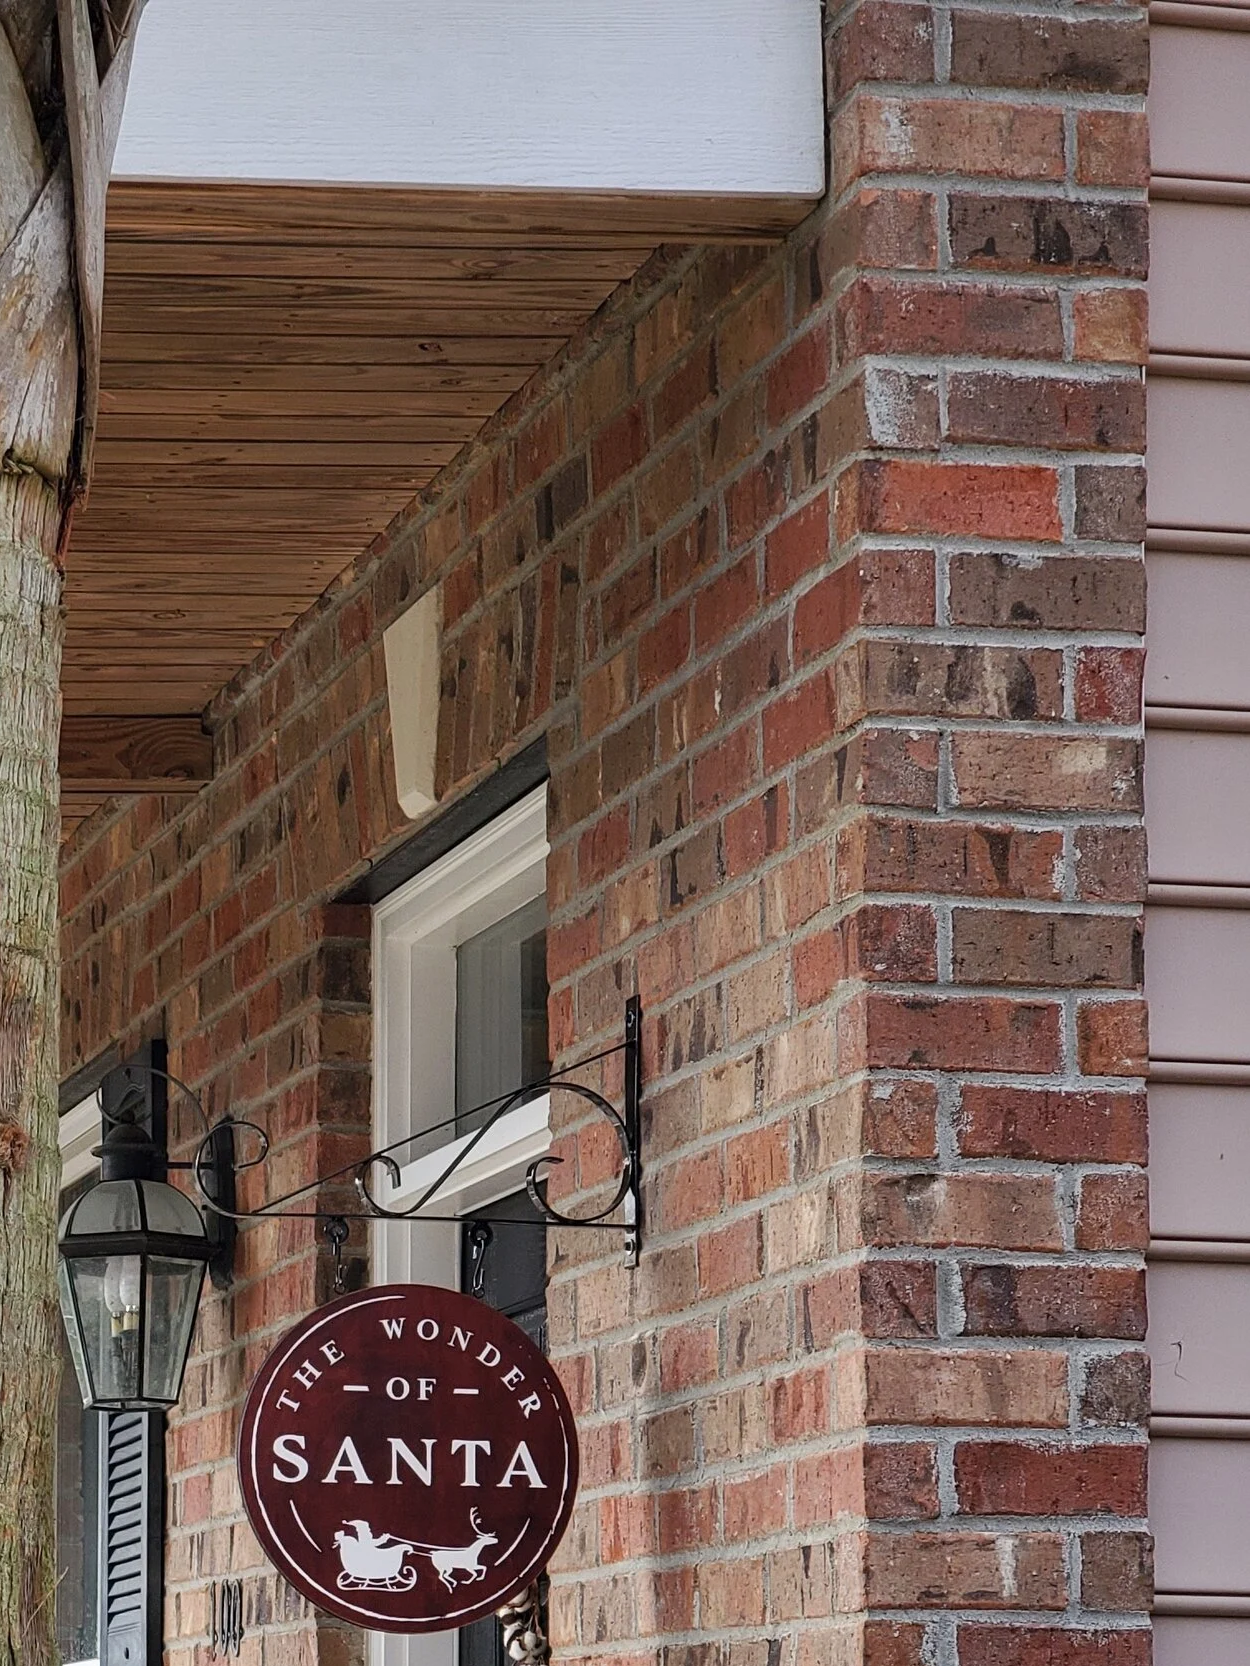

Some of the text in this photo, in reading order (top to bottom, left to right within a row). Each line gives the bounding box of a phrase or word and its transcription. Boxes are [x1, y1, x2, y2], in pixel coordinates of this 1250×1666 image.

[275, 1317, 541, 1419] THE WONDER
[385, 1376, 437, 1401] OF
[272, 1434, 548, 1489] SANTA
